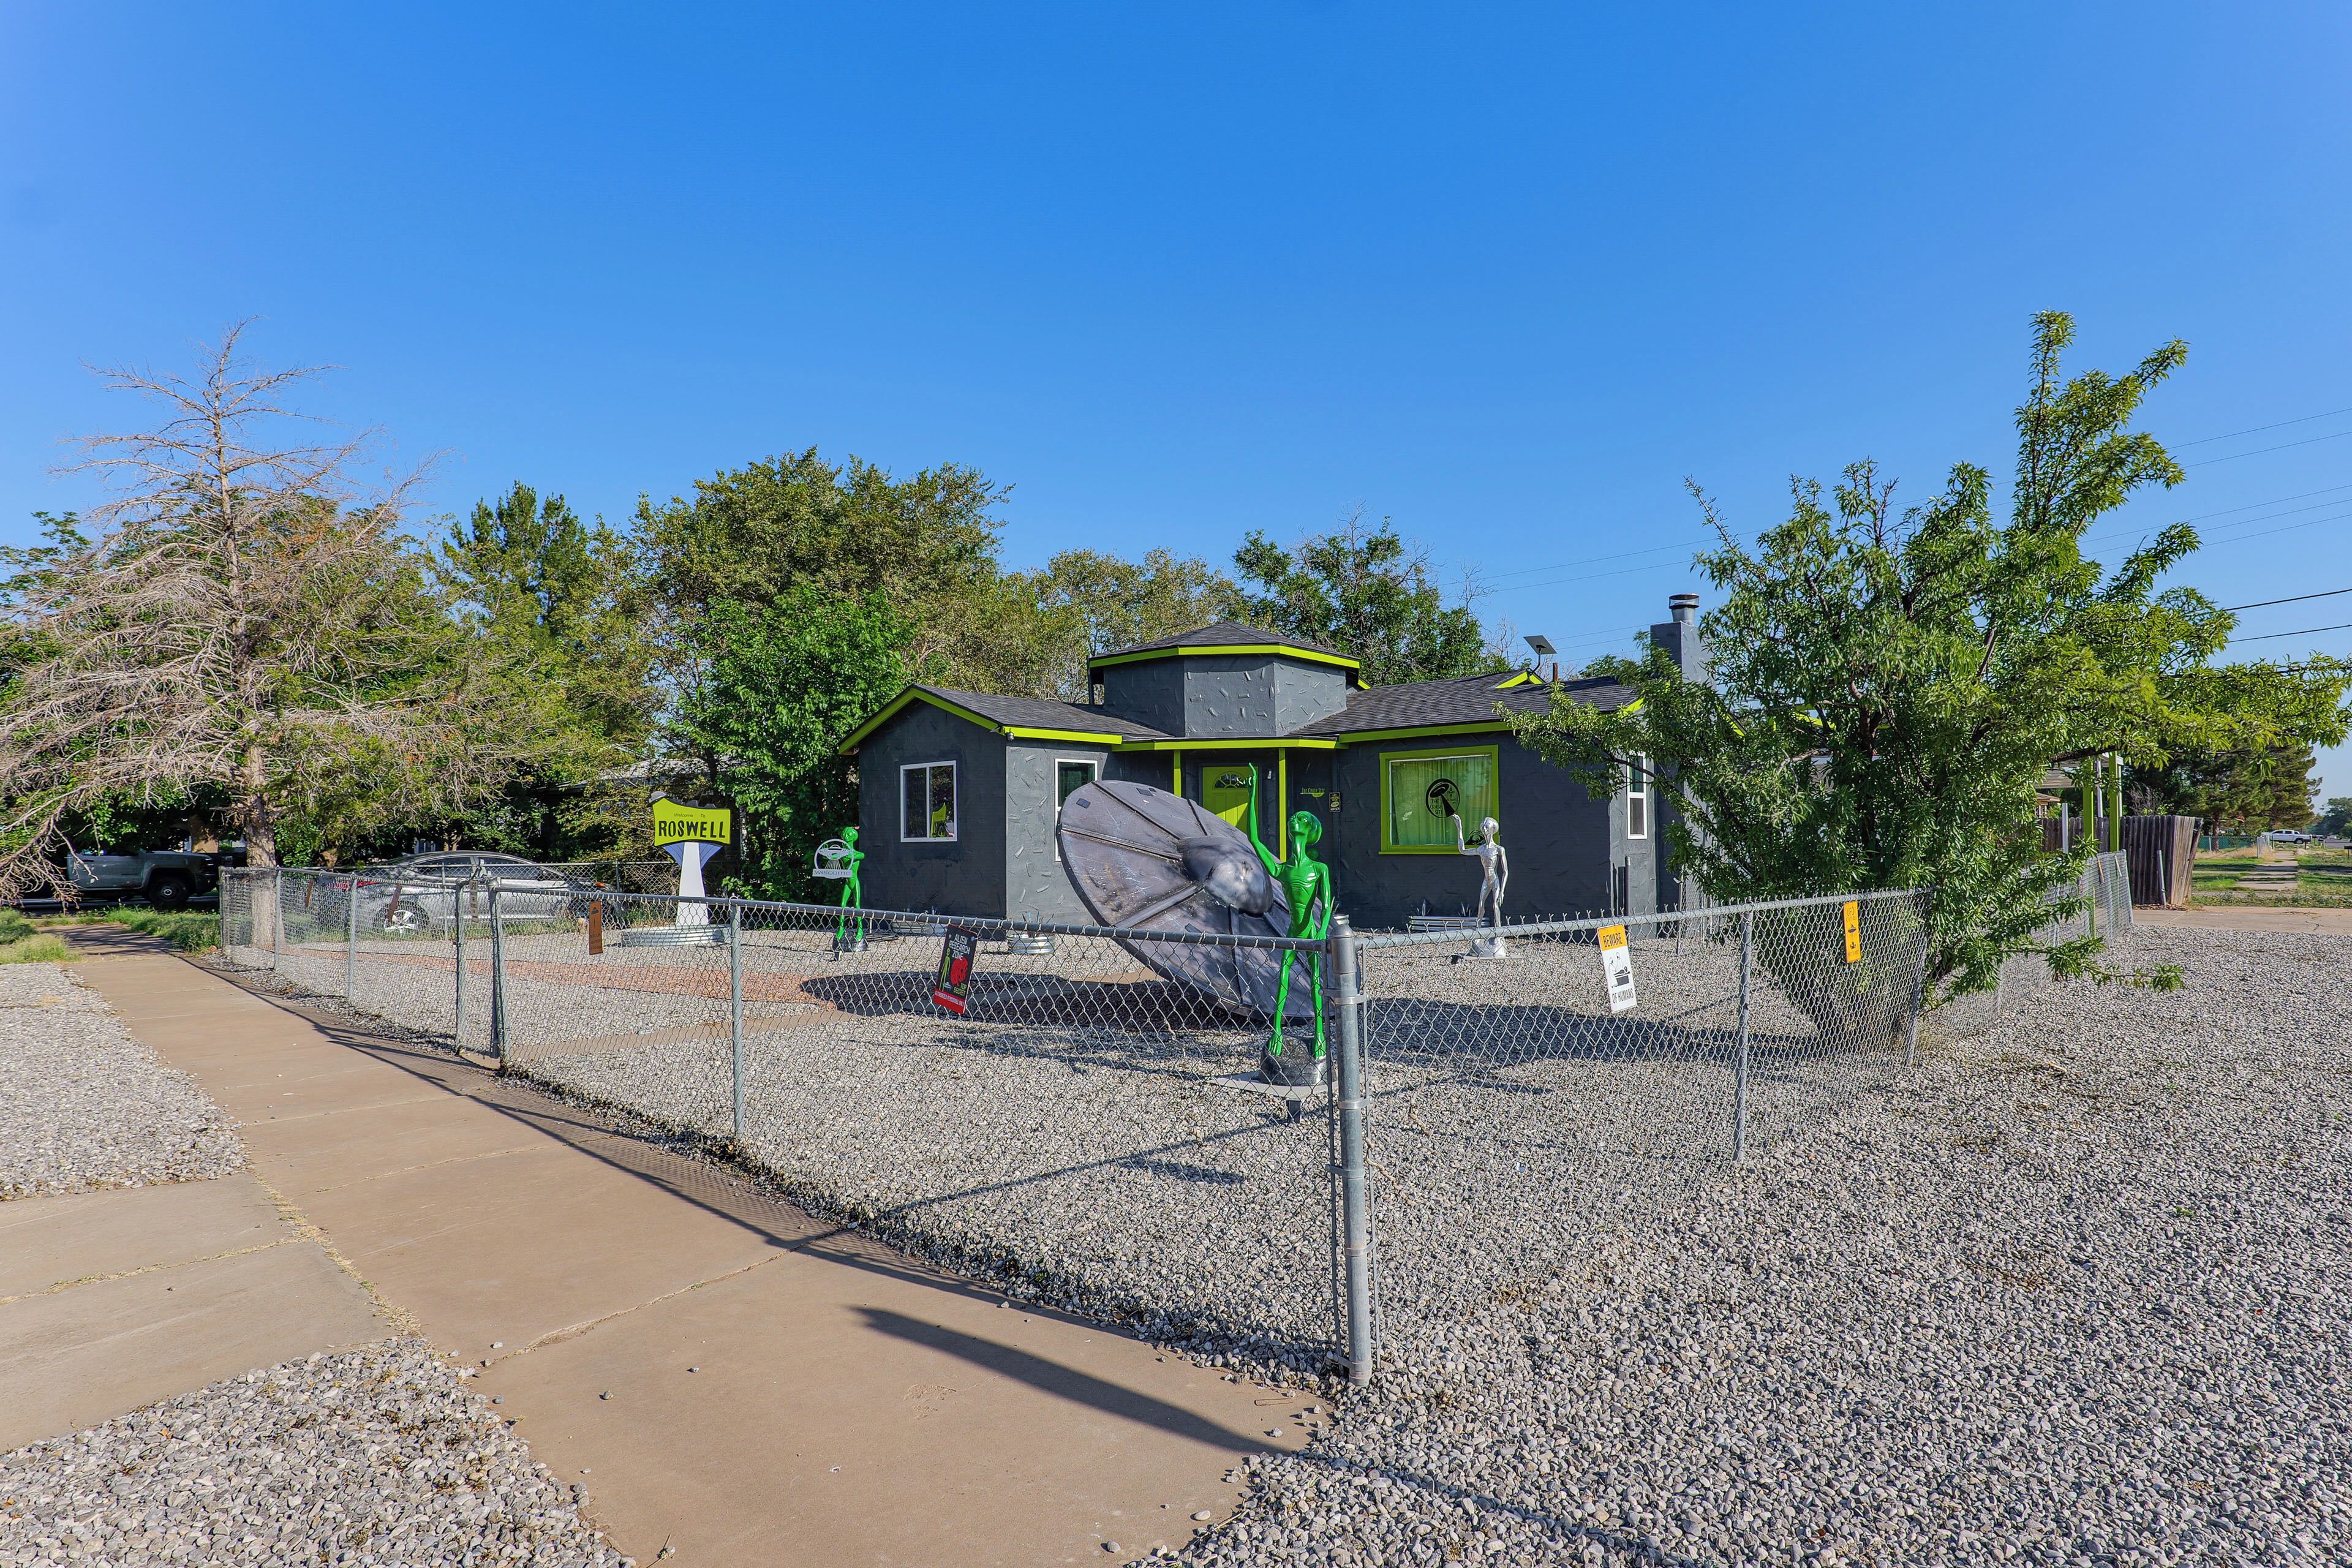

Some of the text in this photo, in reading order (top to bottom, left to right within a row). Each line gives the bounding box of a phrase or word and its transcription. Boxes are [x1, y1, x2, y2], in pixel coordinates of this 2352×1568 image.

[658, 820, 726, 838] ROSWELL
[954, 934, 968, 944] ALIEN
[1603, 932, 1623, 948] BEWARE
[949, 940, 970, 954] RESEARCH
[952, 950, 963, 961] ZONE
[953, 987, 966, 997] SECRET
[1612, 988, 1634, 1004] OF HUMANS
